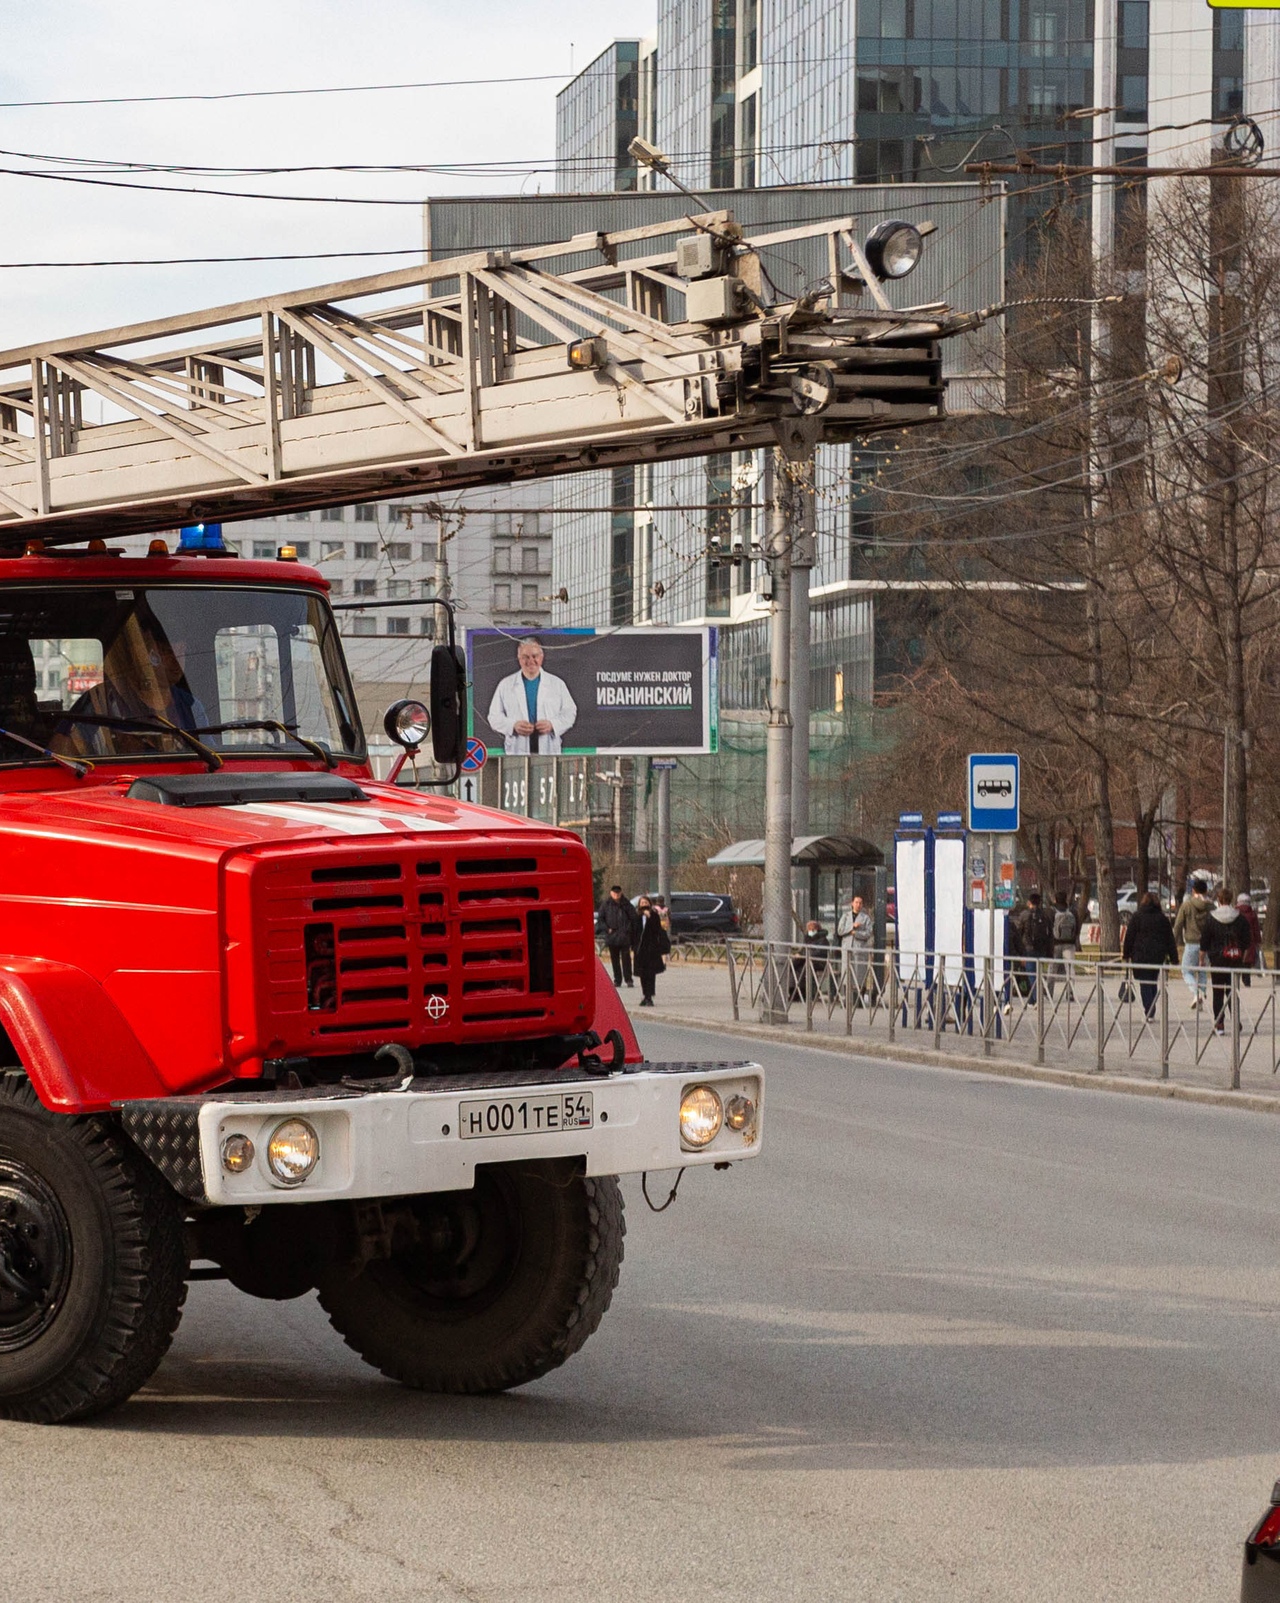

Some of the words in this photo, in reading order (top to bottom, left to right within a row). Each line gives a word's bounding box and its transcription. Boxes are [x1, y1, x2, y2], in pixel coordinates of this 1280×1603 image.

[596, 671, 633, 683] ГОСДУМЕ
[633, 671, 661, 682] НУЖЕН
[661, 671, 692, 682] ДОКТОР
[596, 683, 692, 705] ИВАНИНСКИЙ
[504, 780, 525, 808] 299
[540, 776, 554, 805] 57
[569, 773, 584, 802] 17
[470, 1102, 558, 1133] Н001ТЕ
[564, 1096, 585, 1118] 54
[563, 1117, 578, 1126] RUS
